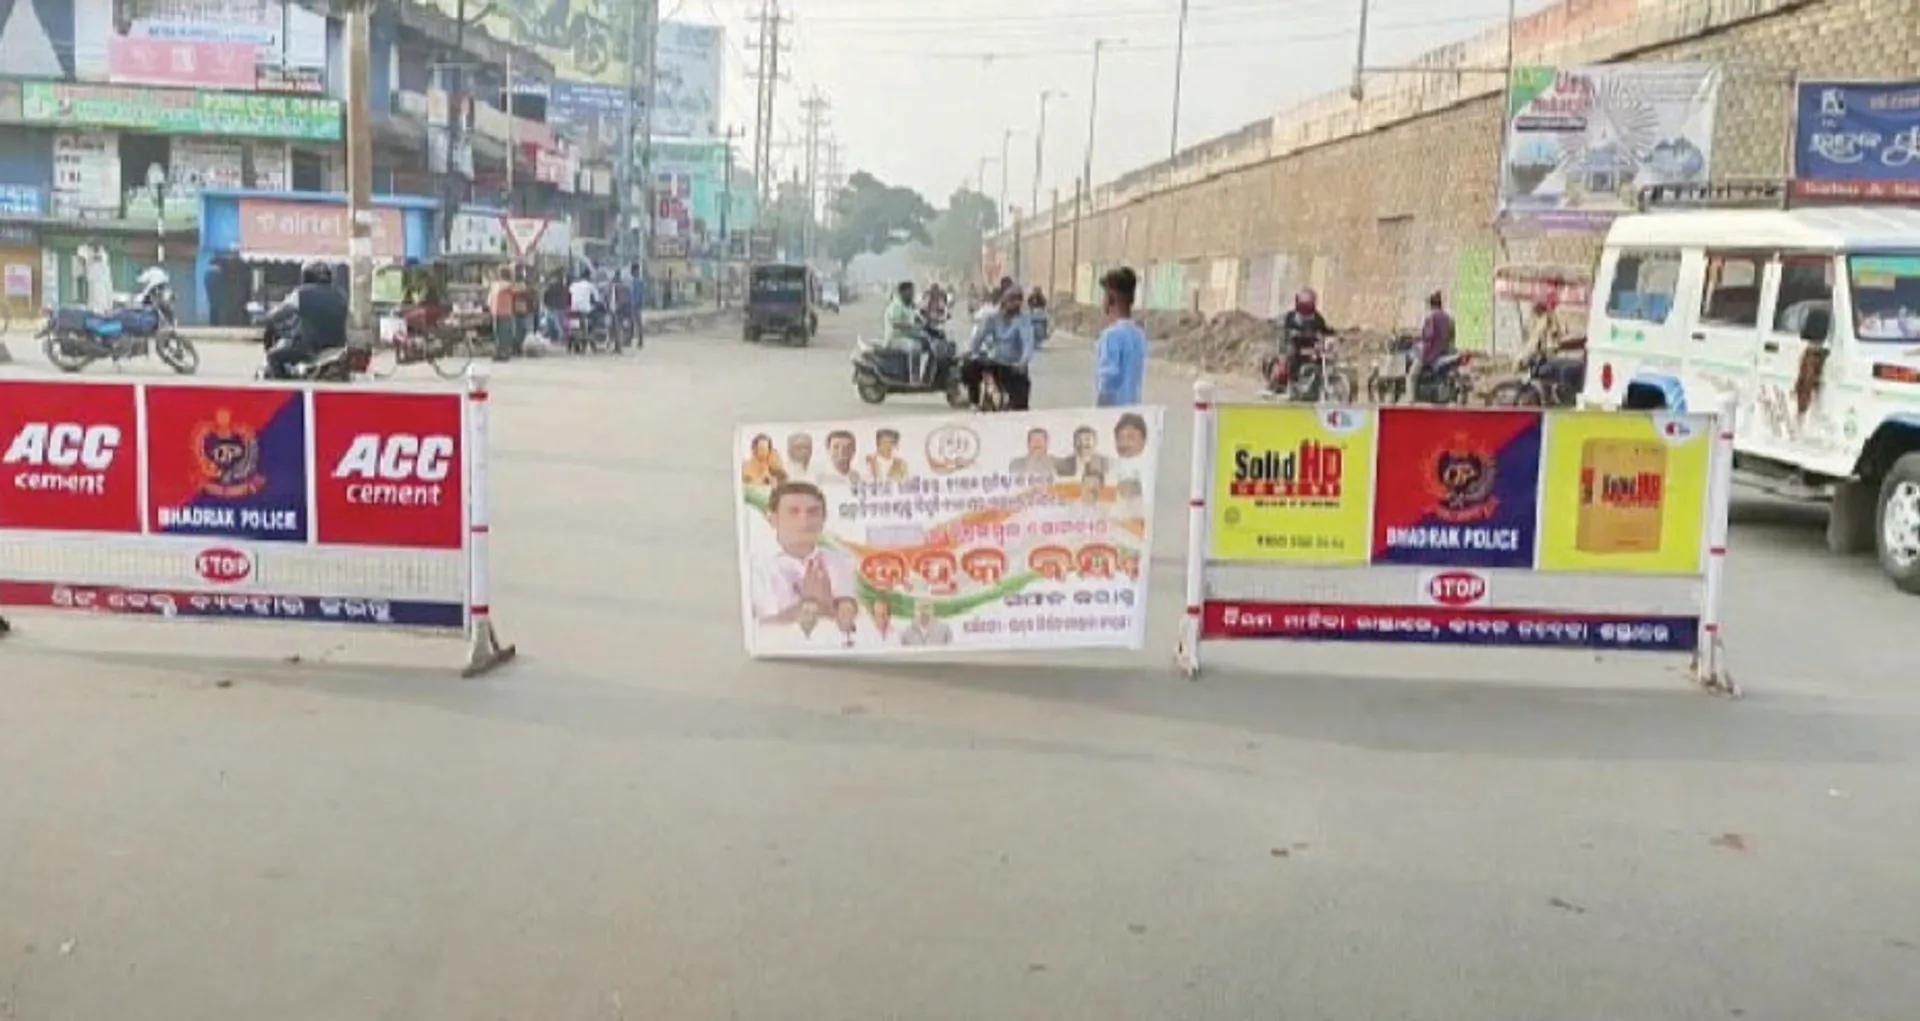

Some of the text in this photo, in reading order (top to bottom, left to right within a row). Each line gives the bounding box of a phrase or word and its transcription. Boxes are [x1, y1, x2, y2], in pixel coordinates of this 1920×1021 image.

[279, 211, 341, 236] airtel
[3, 421, 121, 470] ACC
[331, 431, 454, 481] ACC
[1235, 438, 1342, 485] Solid HD
[14, 472, 104, 494] cement
[346, 483, 442, 506] cement
[158, 505, 297, 530] BHADRAK POLICE
[1386, 525, 1519, 551] BHADRAK POLICE
[201, 553, 249, 578] STOP
[1430, 575, 1484, 600] STOP
